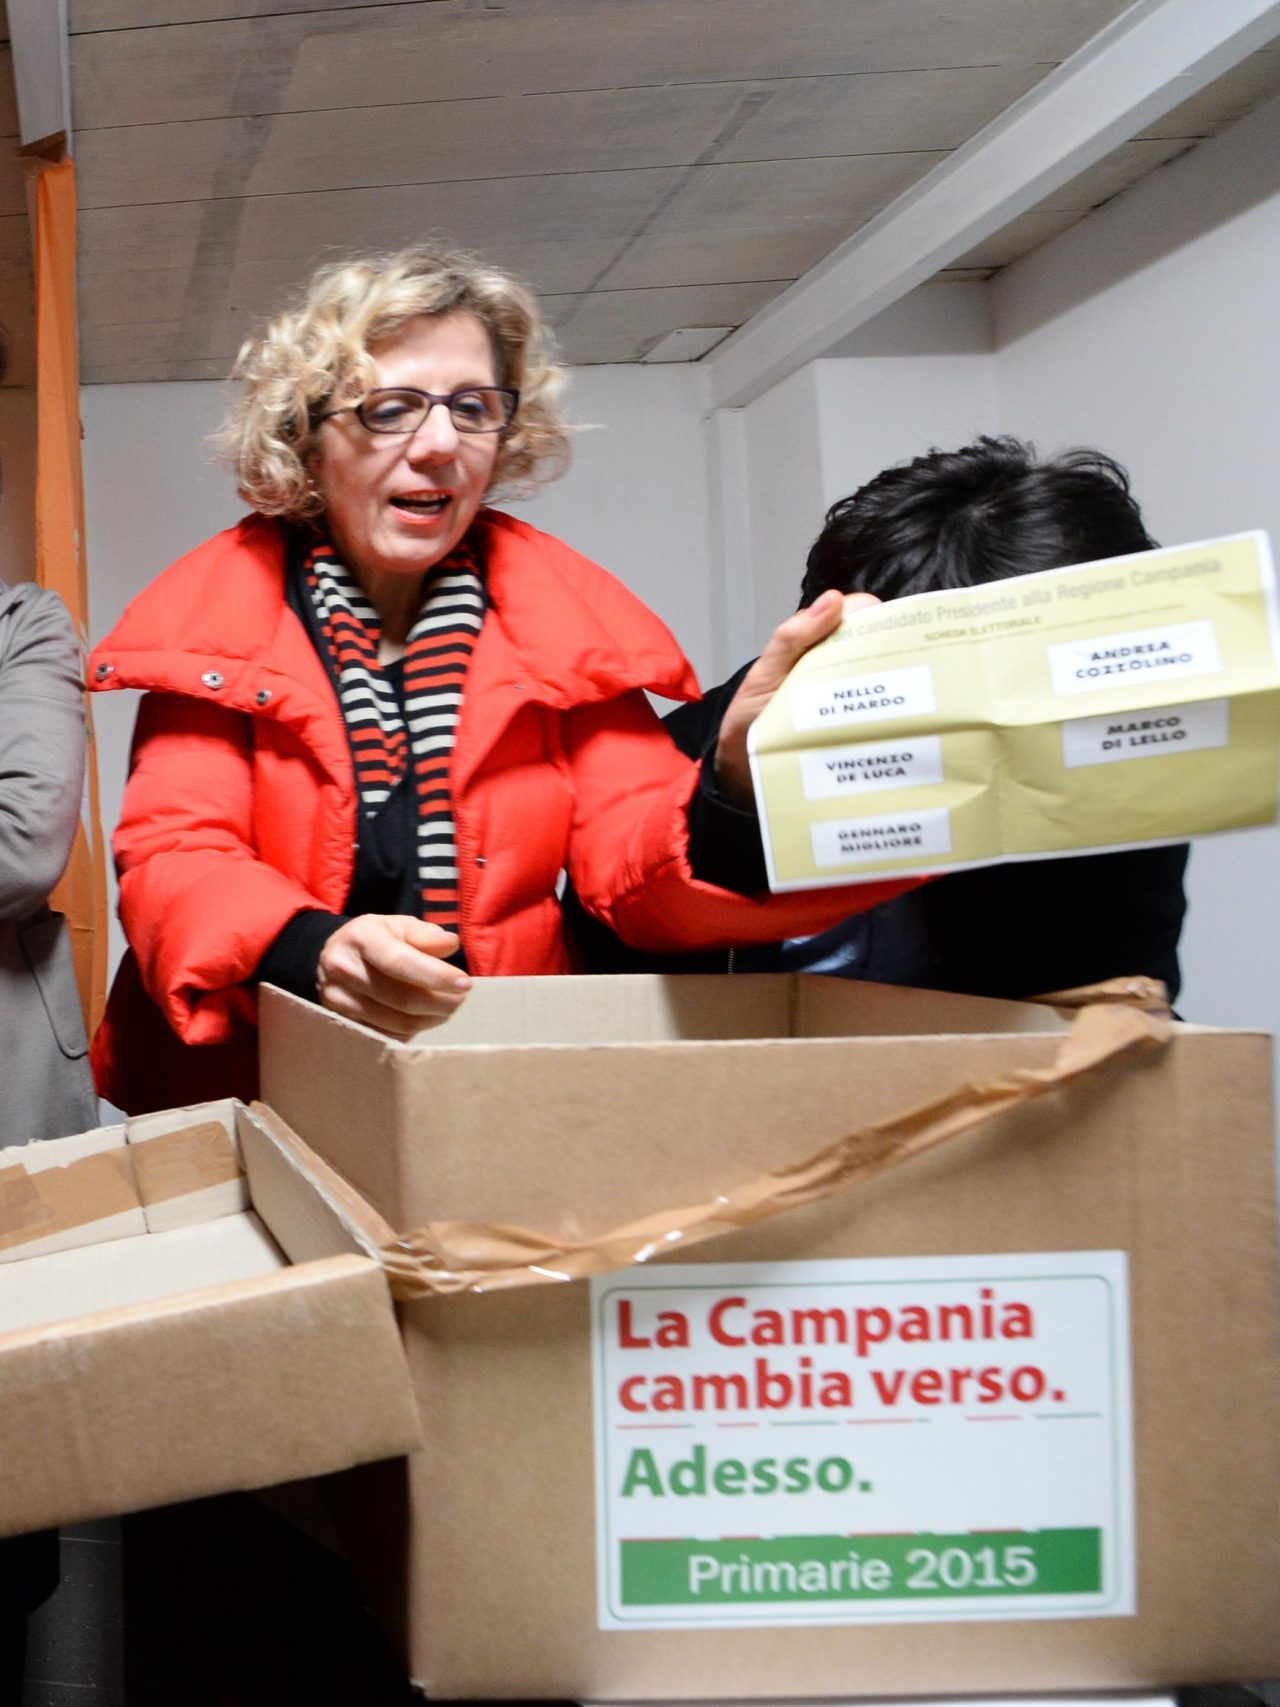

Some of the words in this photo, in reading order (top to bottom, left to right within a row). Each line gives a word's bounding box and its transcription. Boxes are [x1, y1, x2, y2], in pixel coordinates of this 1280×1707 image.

[857, 610, 933, 637] candidato
[936, 595, 1017, 623] Presidente
[1022, 588, 1053, 607] alla
[1057, 576, 1127, 602] Regione
[1131, 558, 1222, 590] Campania
[1091, 640, 1171, 663] ANDREA
[1075, 652, 1194, 681] COZZOLINO
[833, 684, 887, 701] NELLO
[819, 706, 837, 717] DI
[842, 695, 907, 714] NARDO
[1107, 715, 1183, 737] MARCO
[1101, 737, 1124, 752] DI
[1129, 728, 1188, 748] LELLO
[826, 751, 915, 772] VINCENZO
[836, 772, 858, 784] DE
[863, 766, 908, 781] LUCA
[837, 822, 922, 840] GENNARO
[840, 836, 924, 855] MIGLIORE
[617, 1300, 690, 1350] La
[706, 1288, 1035, 1358] Campania
[617, 1357, 854, 1414] cambia
[869, 1365, 1067, 1408] verso.
[618, 1444, 873, 1499] Adesso.
[688, 1552, 893, 1596] Primarie
[904, 1546, 1039, 1591] 2015
